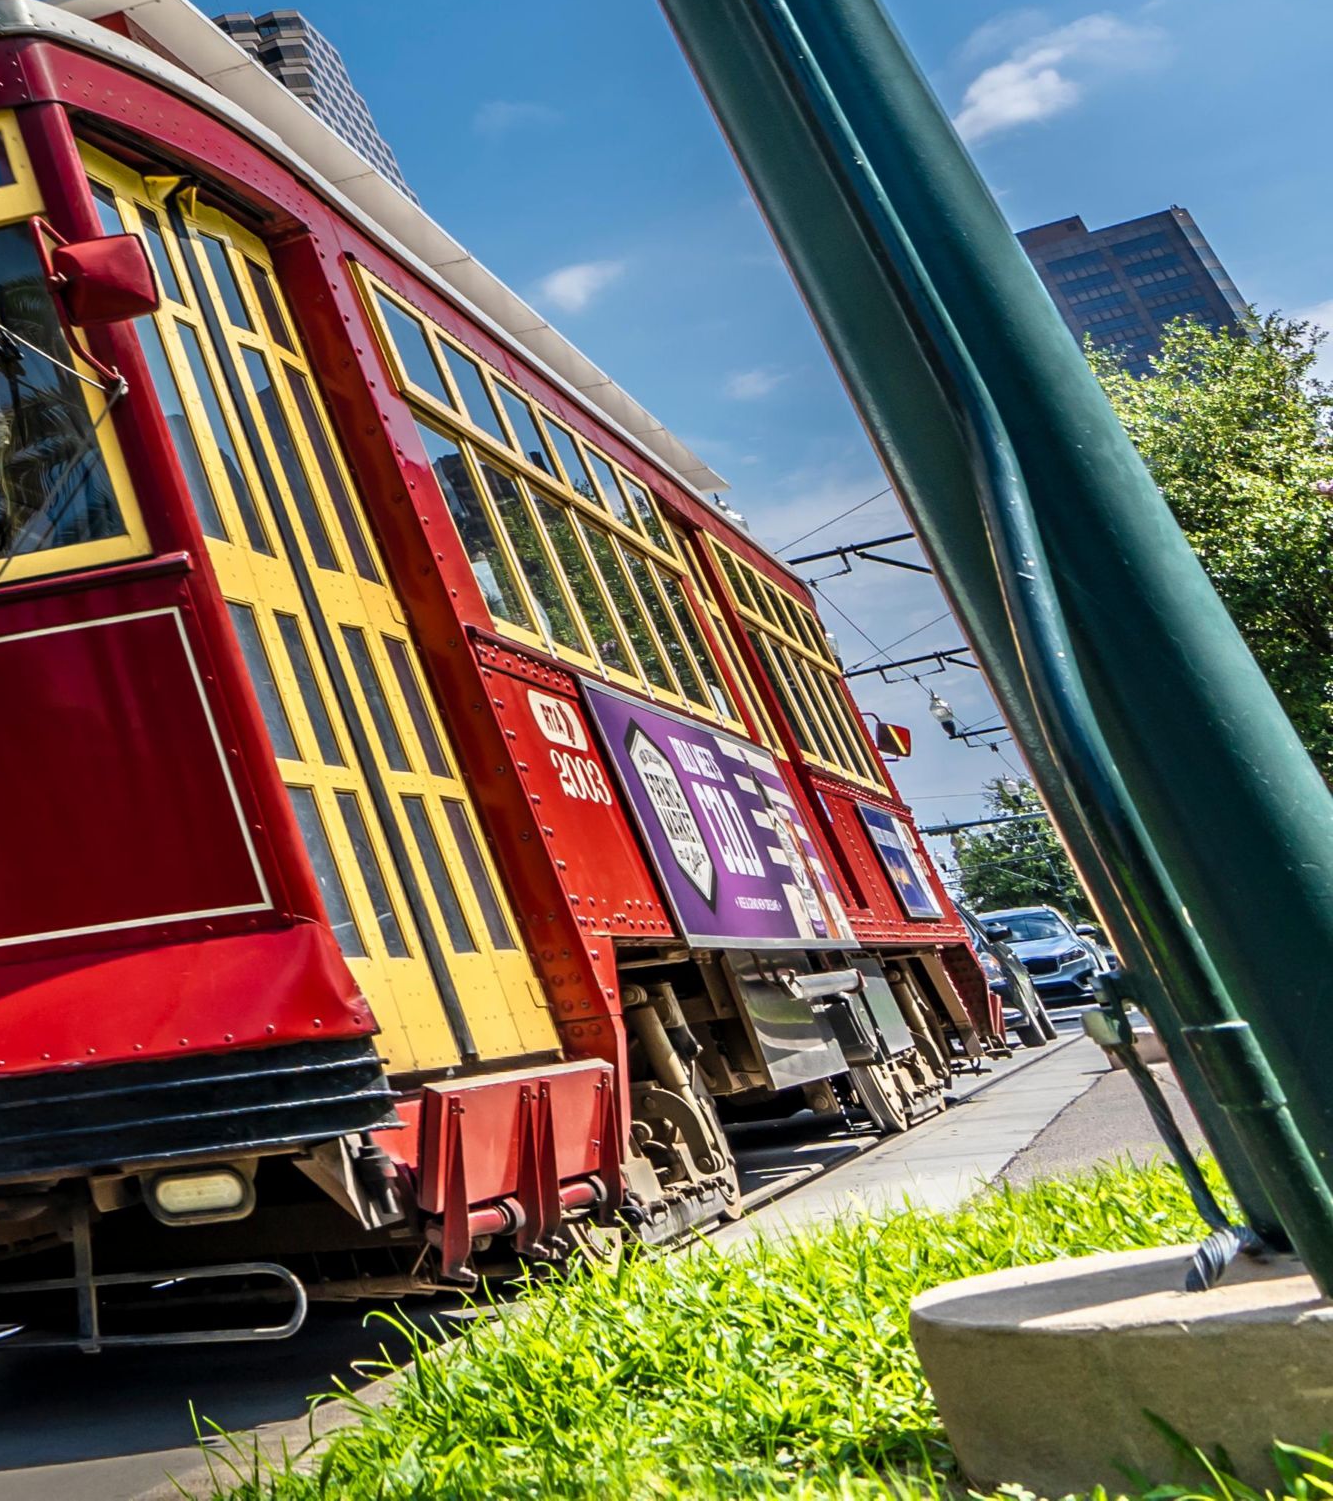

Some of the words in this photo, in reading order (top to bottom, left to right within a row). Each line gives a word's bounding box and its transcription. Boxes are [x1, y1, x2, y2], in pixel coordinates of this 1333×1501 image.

[540, 703, 566, 735] RTA
[550, 749, 612, 806] 2003
[687, 741, 726, 783] MEETS
[643, 772, 688, 812] FRENCH
[658, 806, 701, 845] MARKET
[691, 781, 766, 877] COLD
